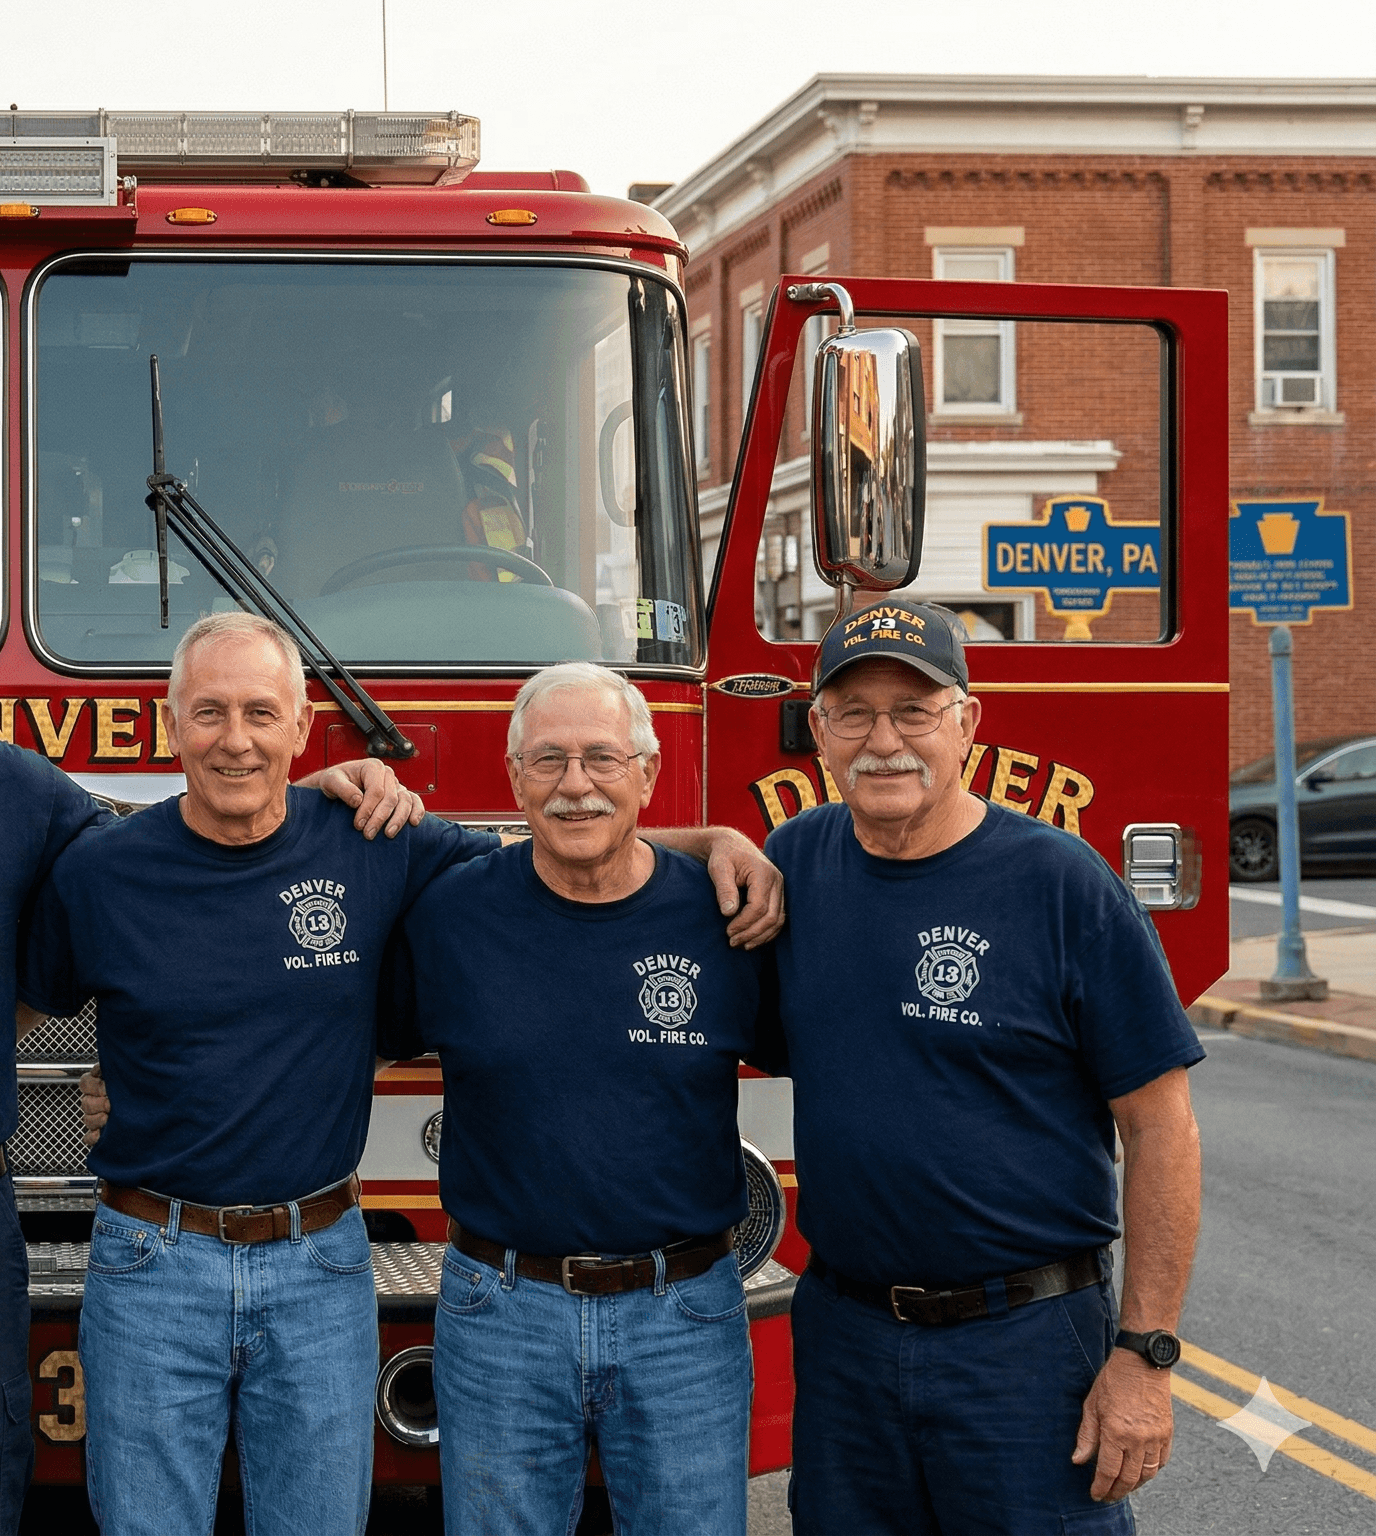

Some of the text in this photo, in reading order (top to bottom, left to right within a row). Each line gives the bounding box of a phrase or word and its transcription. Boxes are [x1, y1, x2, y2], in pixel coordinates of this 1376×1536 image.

[996, 541, 1159, 579] DENVER, PA
[844, 607, 926, 634] DENVER
[872, 617, 896, 630] 13
[871, 629, 901, 640] FIRE
[905, 632, 926, 647] CO.
[278, 879, 346, 905] DENVER
[307, 914, 330, 932] 13
[917, 925, 991, 957] DENVER
[284, 950, 359, 969] VOL. FIRE CO.
[632, 953, 701, 980] DENVER
[934, 964, 960, 983] 13
[658, 991, 680, 1008] 13
[902, 1002, 982, 1026] VOL. FIRE CO.
[628, 1030, 707, 1045] VOL. FIRE CO.
[39, 1350, 86, 1441] 3
